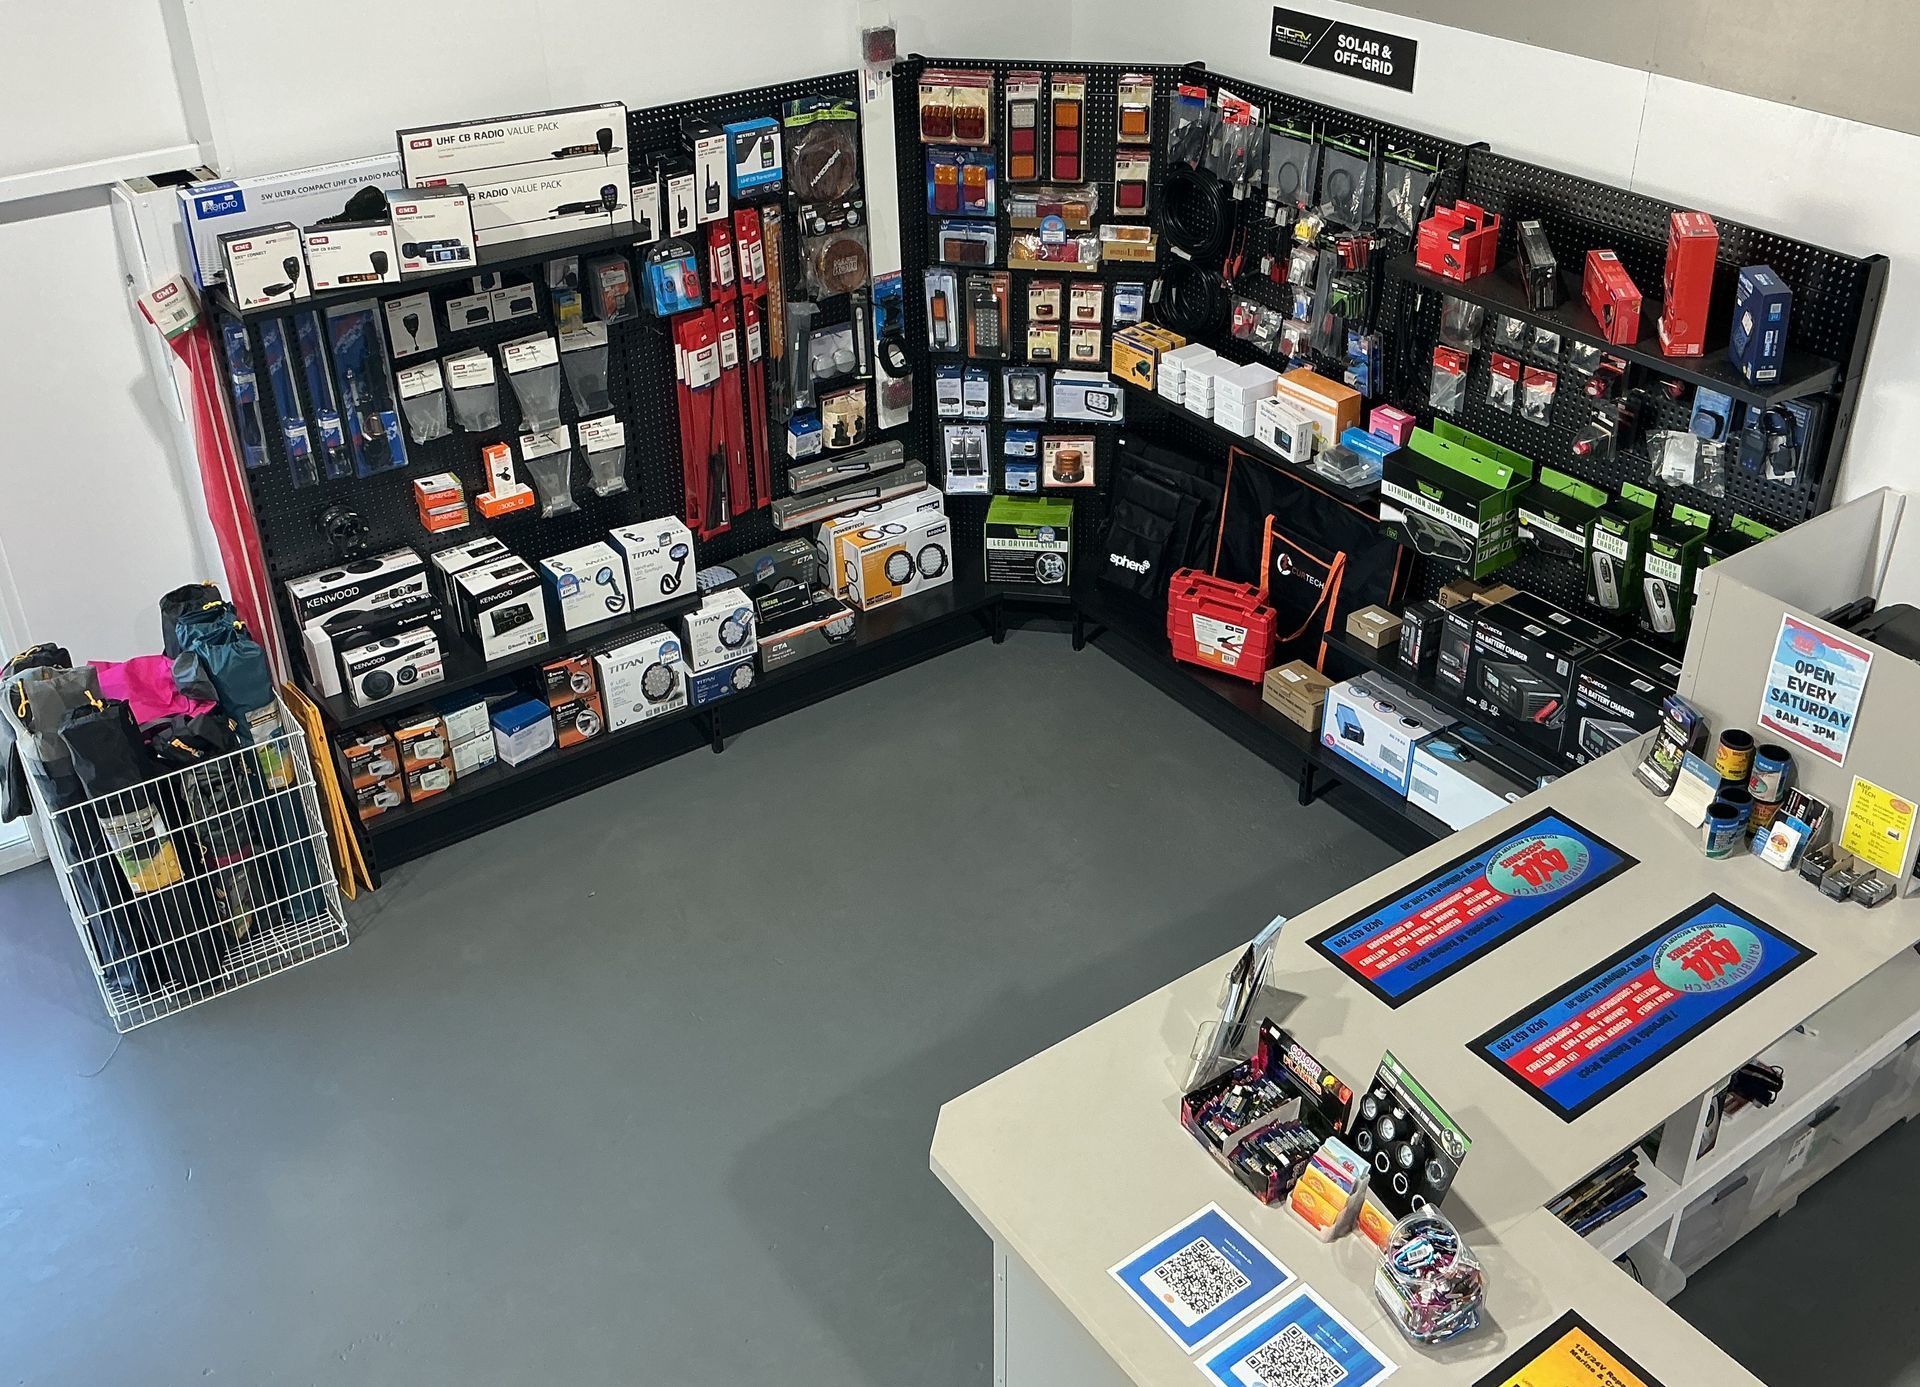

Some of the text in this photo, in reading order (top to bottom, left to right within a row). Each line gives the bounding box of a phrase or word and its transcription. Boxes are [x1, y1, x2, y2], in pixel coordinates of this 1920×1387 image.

[1338, 34, 1392, 59] SOLAR &
[1334, 50, 1393, 76] OFF-GRID
[436, 121, 559, 146] UHF CB RADIO VALUE PACK
[261, 170, 400, 201] 5W ULTRA COMPACT UHF CB RADIO PACK
[479, 180, 562, 199] RADIO VALUE PACK
[202, 195, 238, 214] Aerpro
[154, 284, 175, 300] GME
[1388, 483, 1473, 530] LITHIUM-ION JUMP STARTER
[833, 521, 865, 535] POWERTECH
[1597, 530, 1624, 547] BATTERY
[632, 548, 660, 560] TITAN
[861, 542, 888, 554] POWERTECH
[1596, 538, 1624, 556] CHARGER
[1110, 553, 1145, 574] sphere
[1648, 563, 1677, 580] CHARGER
[1649, 556, 1678, 572] BATTERY
[306, 587, 360, 609] KENWOOD
[480, 590, 512, 604] KENWOOD
[694, 615, 721, 627] TITAN
[1477, 620, 1503, 636] PROJECTA
[1475, 630, 1528, 662] 25A BATTERY CHARGER
[353, 656, 386, 671] KENWOOD
[608, 657, 644, 674] TITAN
[699, 659, 710, 667] LV
[1795, 660, 1835, 685] OPEN
[697, 676, 715, 685] TITAN
[1580, 673, 1608, 691] PROJECTA
[1787, 675, 1837, 704] EVERY
[1577, 683, 1635, 719] 25A BATTERY CHARGER
[1770, 688, 1851, 728] SATURDAY
[616, 719, 627, 727] LV
[1775, 709, 1835, 740] 8AM 3PM
[1857, 781, 1872, 791] AMP
[1861, 788, 1876, 800] TECH
[1850, 811, 1875, 827] PROCELL
[1496, 839, 1548, 869] ACCESSORIES
[1512, 851, 1587, 894] RAINBOW BEACH
[1397, 860, 1486, 911] www.rainbow4x4.com.au
[1418, 891, 1466, 919] COMMUNICATIONS
[1432, 907, 1459, 923] CARAVAN
[1465, 893, 1503, 916] SOLAR PANELS
[1346, 928, 1366, 940] 453
[1365, 925, 1406, 950] COMPRESSORS
[1391, 934, 1412, 947] PARTS
[1407, 923, 1431, 938] TRAILER
[1413, 917, 1463, 946] RECOVERY TRACKS
[1425, 939, 1459, 960] Rainbow
[1663, 928, 1716, 962] ACCESSORIES
[1357, 947, 1388, 966] BATTERIES
[1374, 947, 1411, 970] LED LIGHTING
[1404, 956, 1430, 972] Beach
[1683, 941, 1759, 990] RAINBOW BEACH
[1561, 952, 1652, 1009] www.rainbow4x4.com.au
[1584, 986, 1634, 1019] COMMUNICATIONS
[1634, 989, 1674, 1015] SOLAR PANELS
[1600, 1005, 1628, 1023] CARAVAN
[1508, 1028, 1530, 1043] 453
[1529, 1025, 1573, 1054] COMPRESSORS
[1574, 1023, 1600, 1040] TRAILER
[1582, 1016, 1633, 1050] RECOVERY TRACKS
[1558, 1035, 1580, 1050] PARTS
[1597, 1040, 1632, 1064] Rainbow
[1290, 1044, 1322, 1075] COLOUR
[1523, 1051, 1556, 1073] BATTERIES
[1541, 1050, 1580, 1077] LED LIGHTING
[1575, 1060, 1603, 1079] Beach
[1569, 1348, 1605, 1381] Marine &
[1575, 1342, 1607, 1372] 12V/24V
